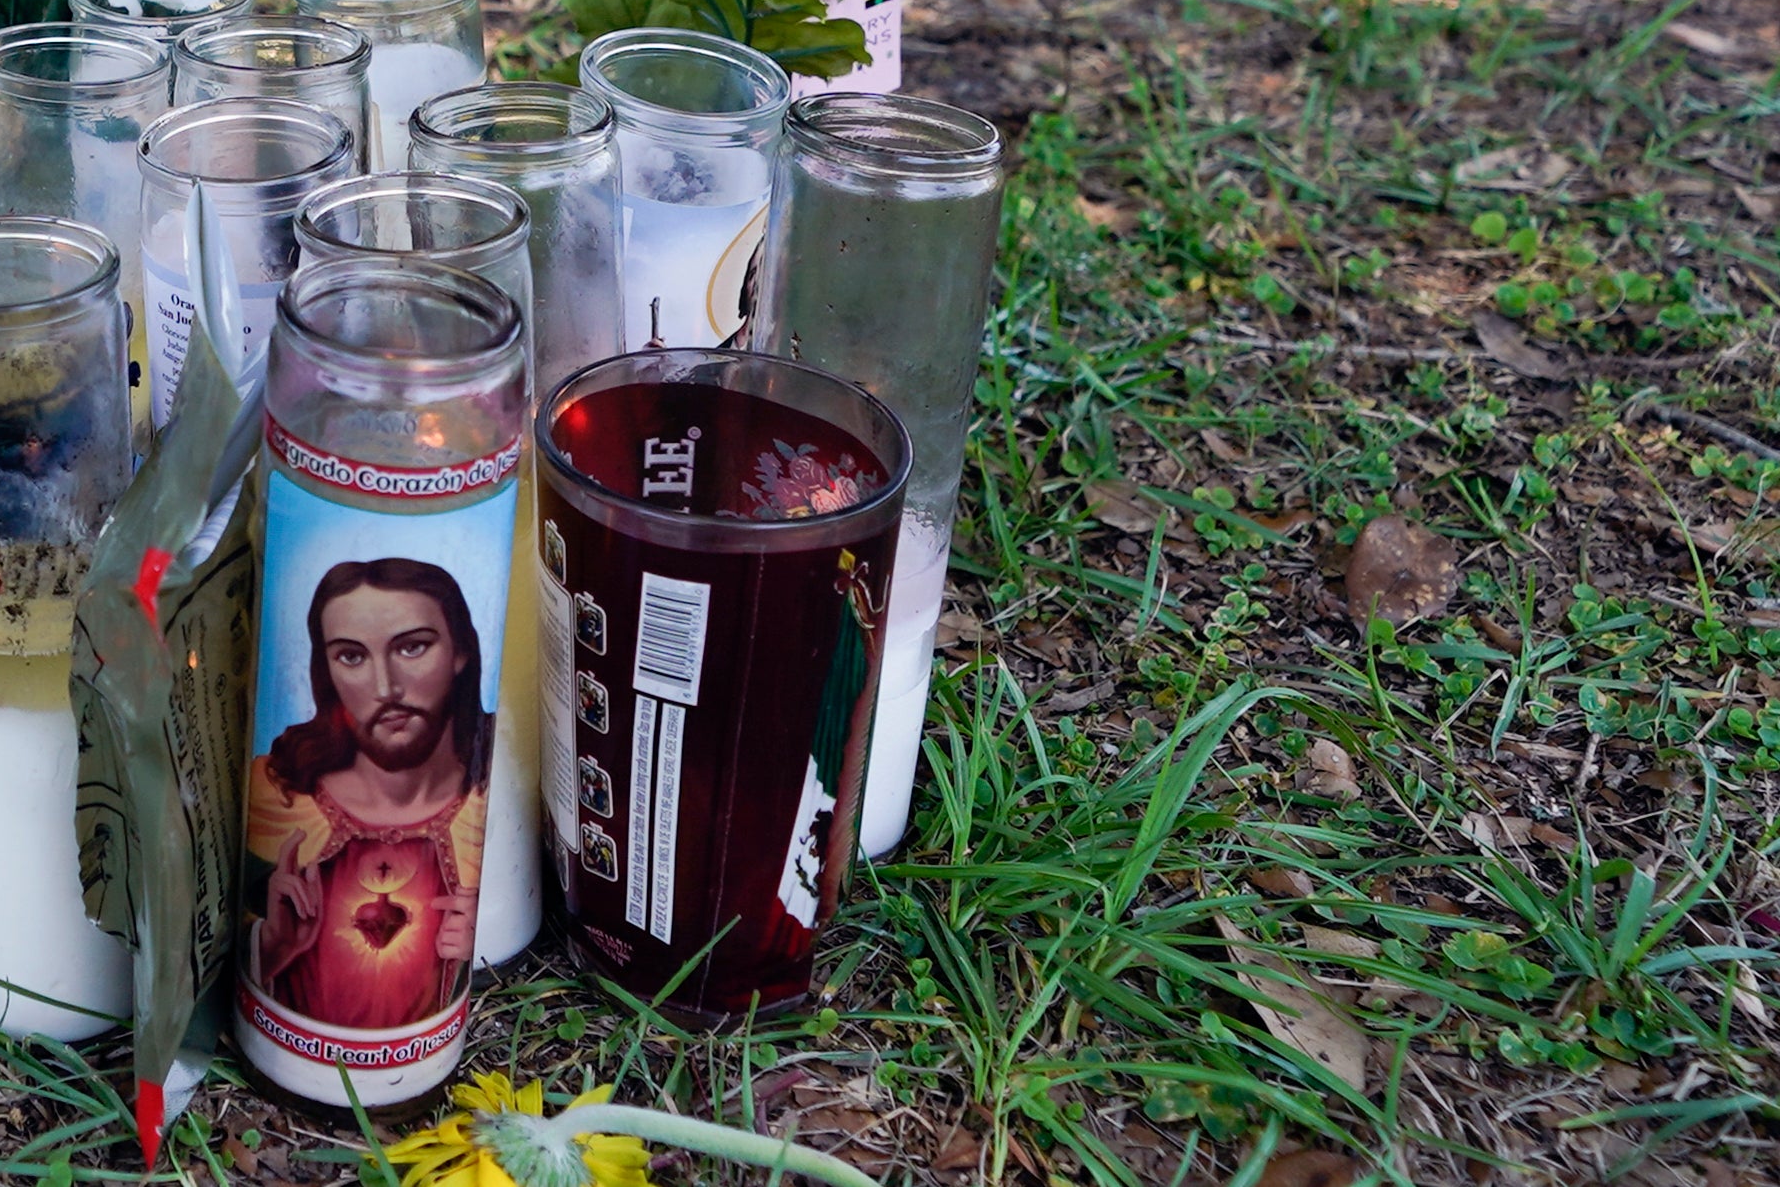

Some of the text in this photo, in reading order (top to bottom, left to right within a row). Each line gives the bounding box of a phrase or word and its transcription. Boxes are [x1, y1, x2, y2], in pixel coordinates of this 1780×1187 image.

[864, 12, 892, 31] RY
[158, 301, 174, 319] San
[356, 464, 465, 495] Corazón
[467, 460, 494, 485] de
[186, 768, 207, 905] Emergency
[253, 1005, 463, 1066] Sacred Heart of Jesus
